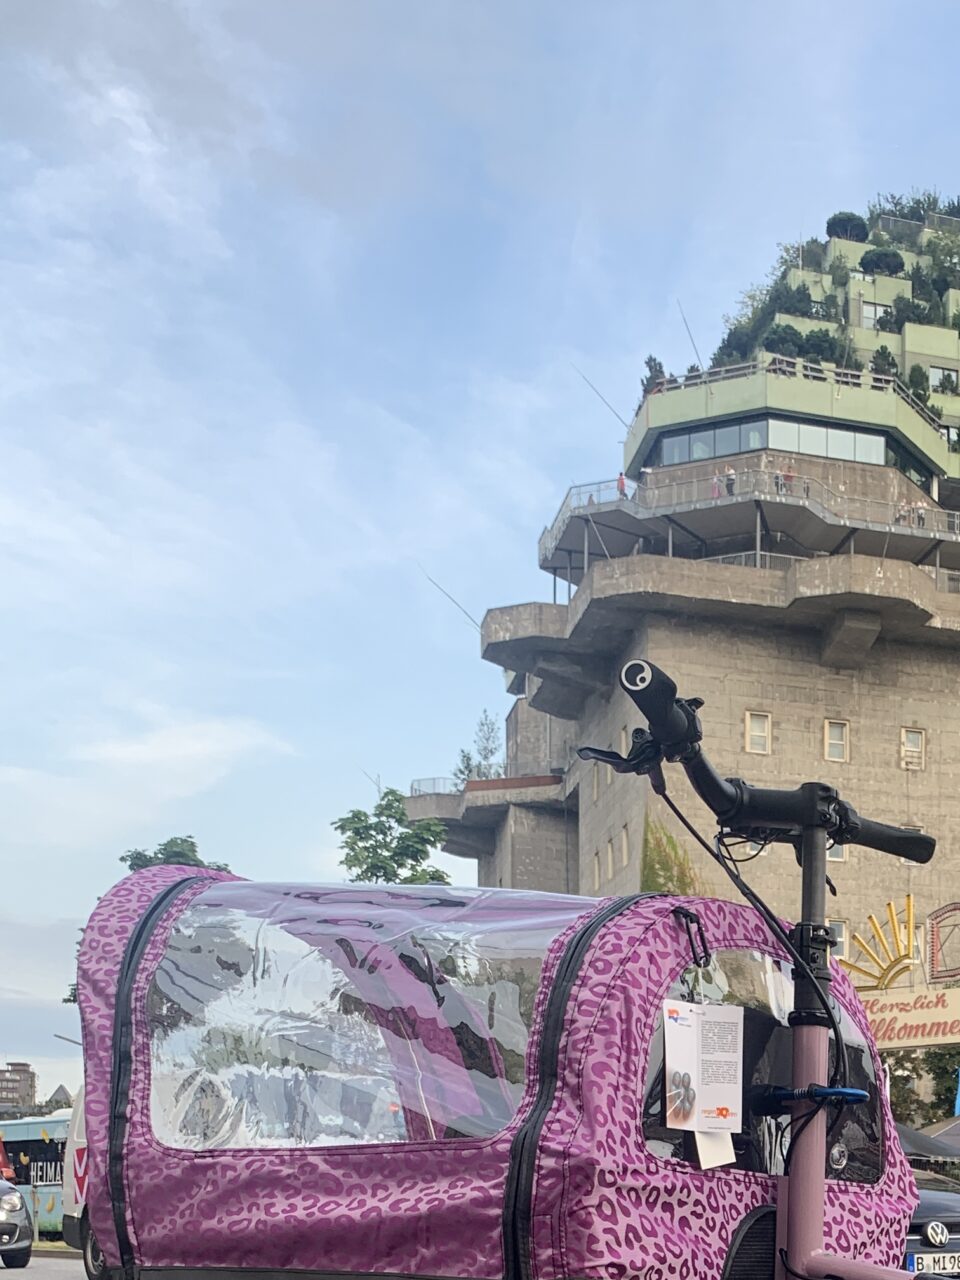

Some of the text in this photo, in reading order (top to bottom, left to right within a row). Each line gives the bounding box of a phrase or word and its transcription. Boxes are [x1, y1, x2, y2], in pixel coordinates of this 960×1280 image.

[863, 993, 949, 1015] Herzlich
[30, 1161, 65, 1185] HEIMA
[916, 1256, 925, 1272] B
